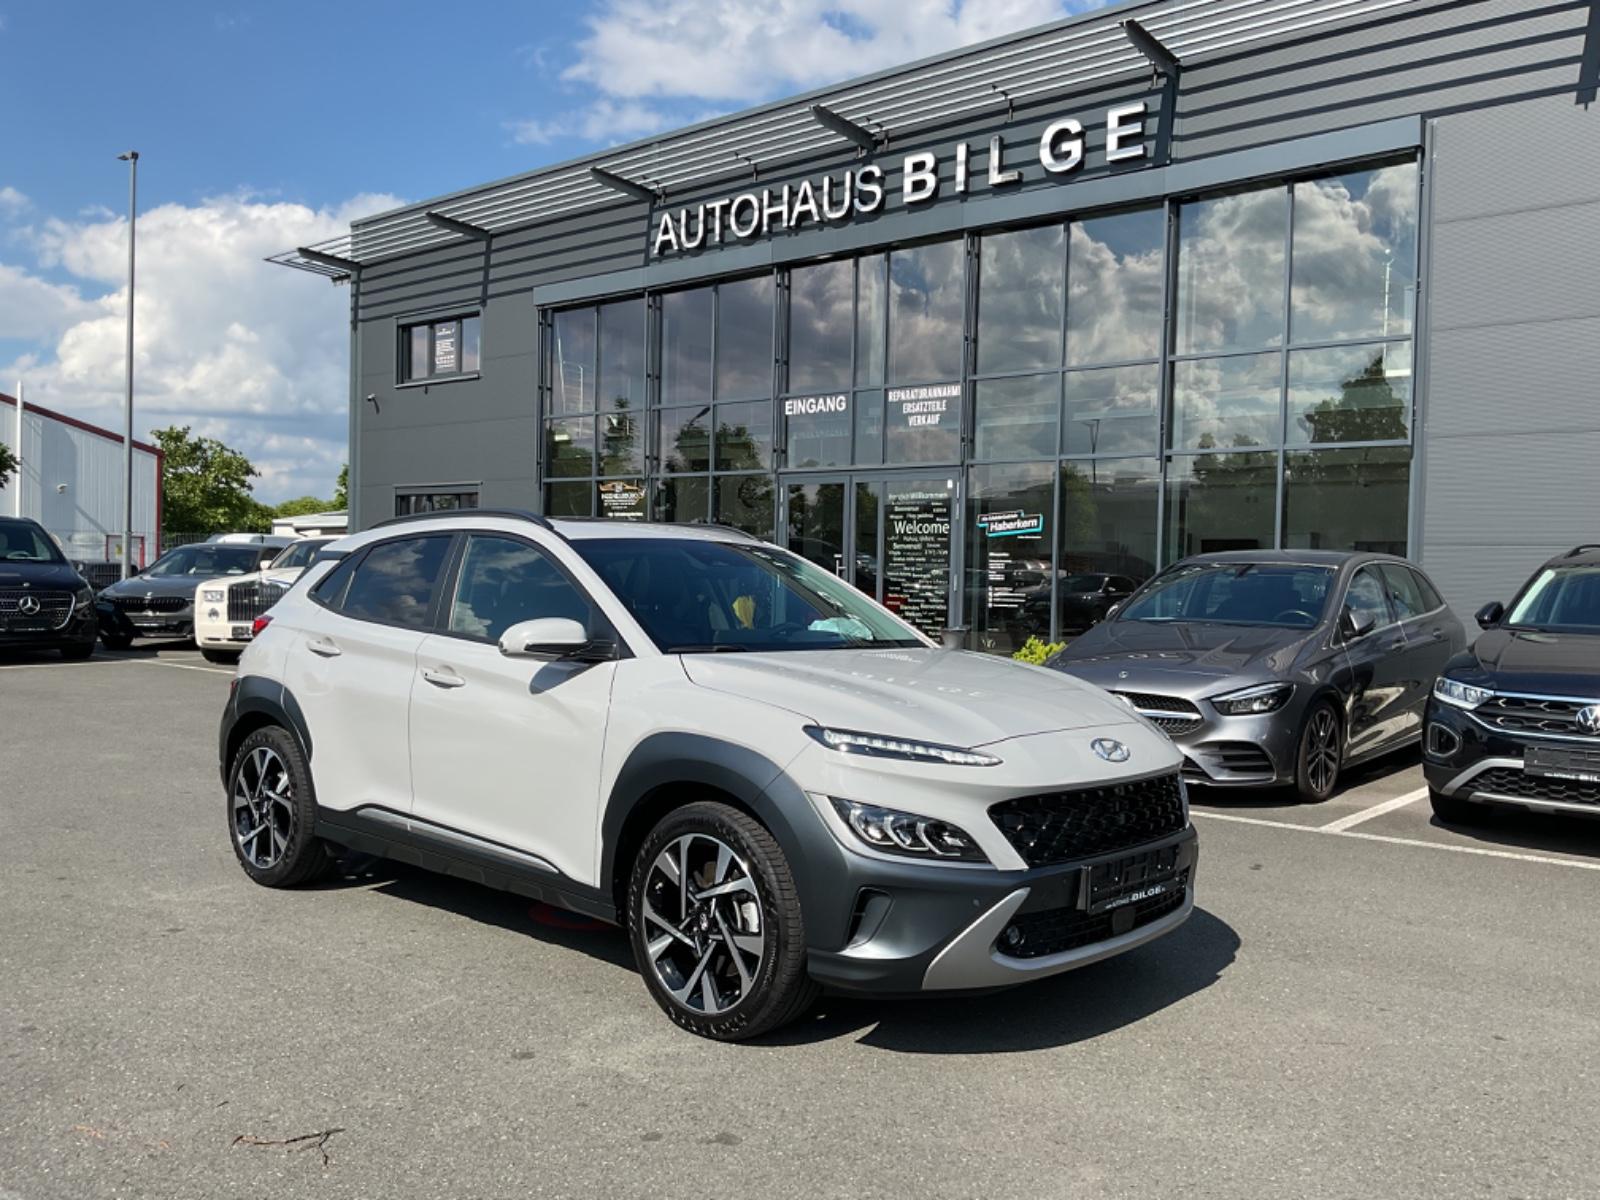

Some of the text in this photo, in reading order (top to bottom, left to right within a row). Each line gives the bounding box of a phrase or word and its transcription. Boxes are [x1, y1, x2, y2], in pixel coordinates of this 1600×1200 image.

[653, 102, 1148, 255] AUTOHAUS BILGE
[784, 395, 847, 416] EINGANG
[902, 399, 948, 414] ERSATZTEILE
[908, 413, 941, 427] VERKAUF
[894, 520, 950, 534] Welcome
[989, 519, 1038, 532] Haberkern
